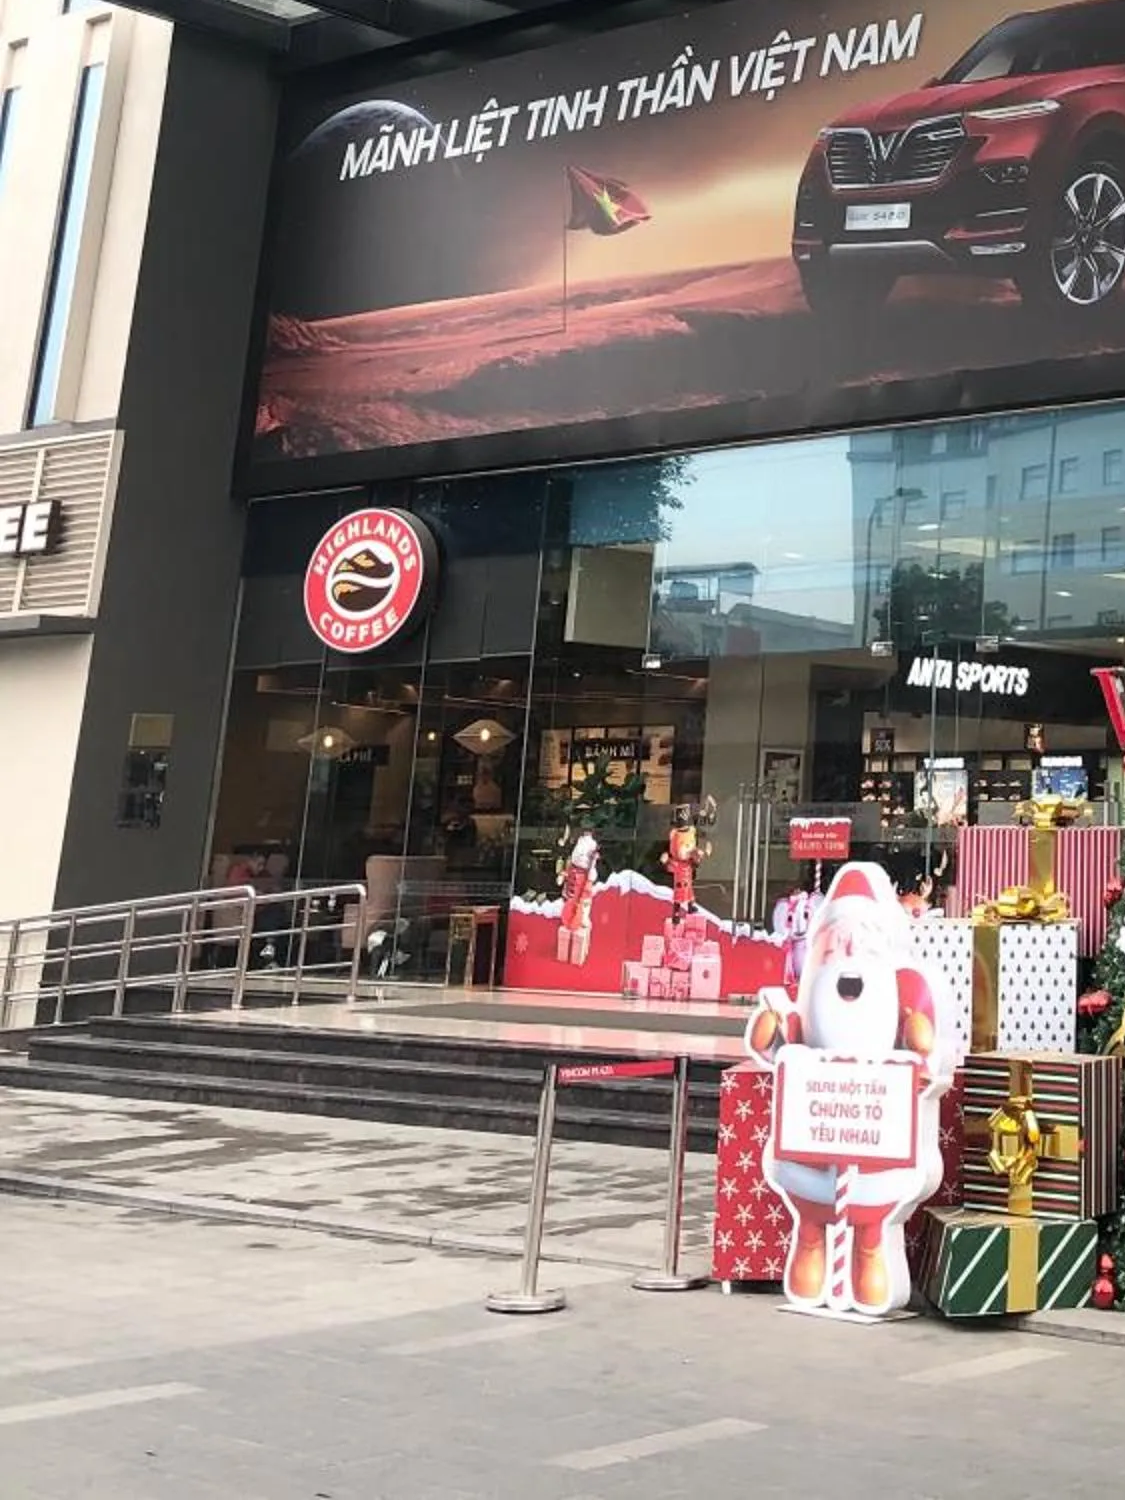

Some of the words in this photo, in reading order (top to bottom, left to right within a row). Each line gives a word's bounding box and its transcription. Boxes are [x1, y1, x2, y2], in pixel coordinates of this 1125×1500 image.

[339, 122, 442, 181] MÃNH
[444, 97, 519, 163] LIỆT
[526, 85, 609, 142] TINH
[617, 45, 720, 121] THẦN
[730, 29, 817, 101] VIỆT
[819, 13, 923, 77] NAM
[313, 517, 417, 576] HIGHLANDS
[319, 607, 399, 643] COFFEE
[907, 656, 952, 689] ANTA
[955, 661, 1031, 697] SPORTS
[809, 1098, 860, 1119] CHỨNG
[809, 1121, 835, 1144] YÊU
[839, 1127, 881, 1146] NHAU
